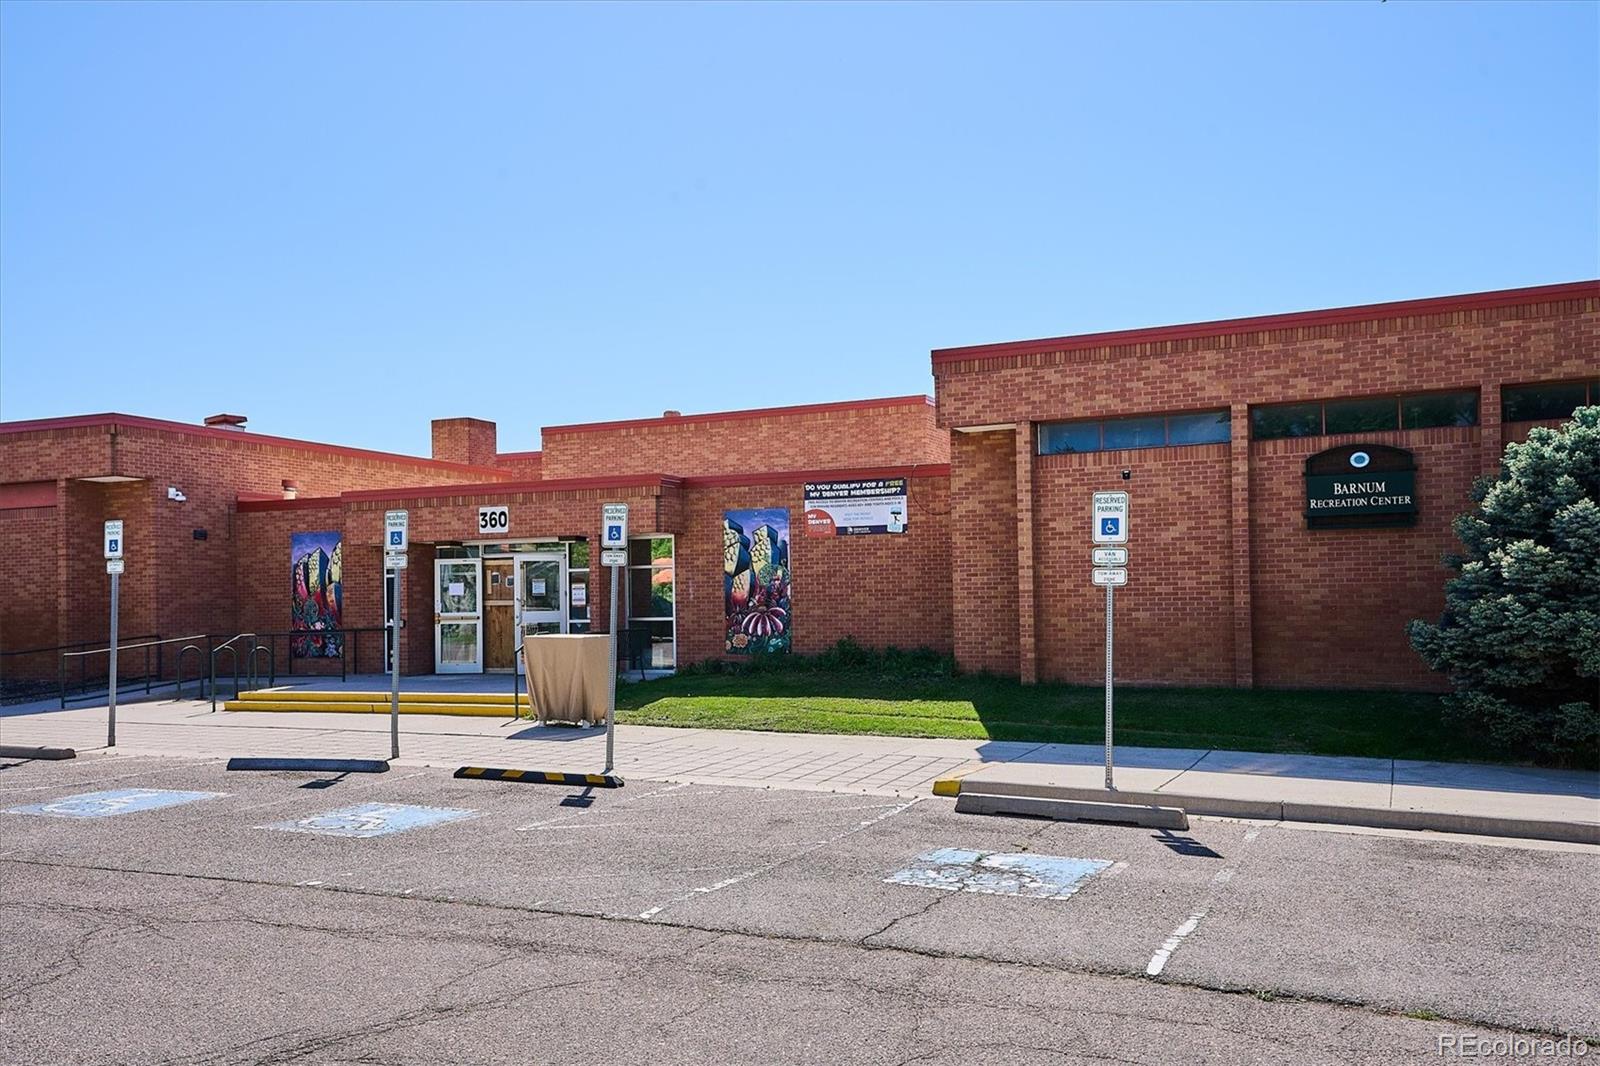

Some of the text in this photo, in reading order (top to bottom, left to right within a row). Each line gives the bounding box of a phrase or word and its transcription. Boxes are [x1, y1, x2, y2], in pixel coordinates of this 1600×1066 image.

[832, 482, 861, 490] QUALIFY
[850, 486, 901, 496] MEMBERSHIP?
[1333, 481, 1386, 495] BARNUM
[1310, 495, 1412, 509] RECREATION CENTER
[480, 511, 508, 529] 360
